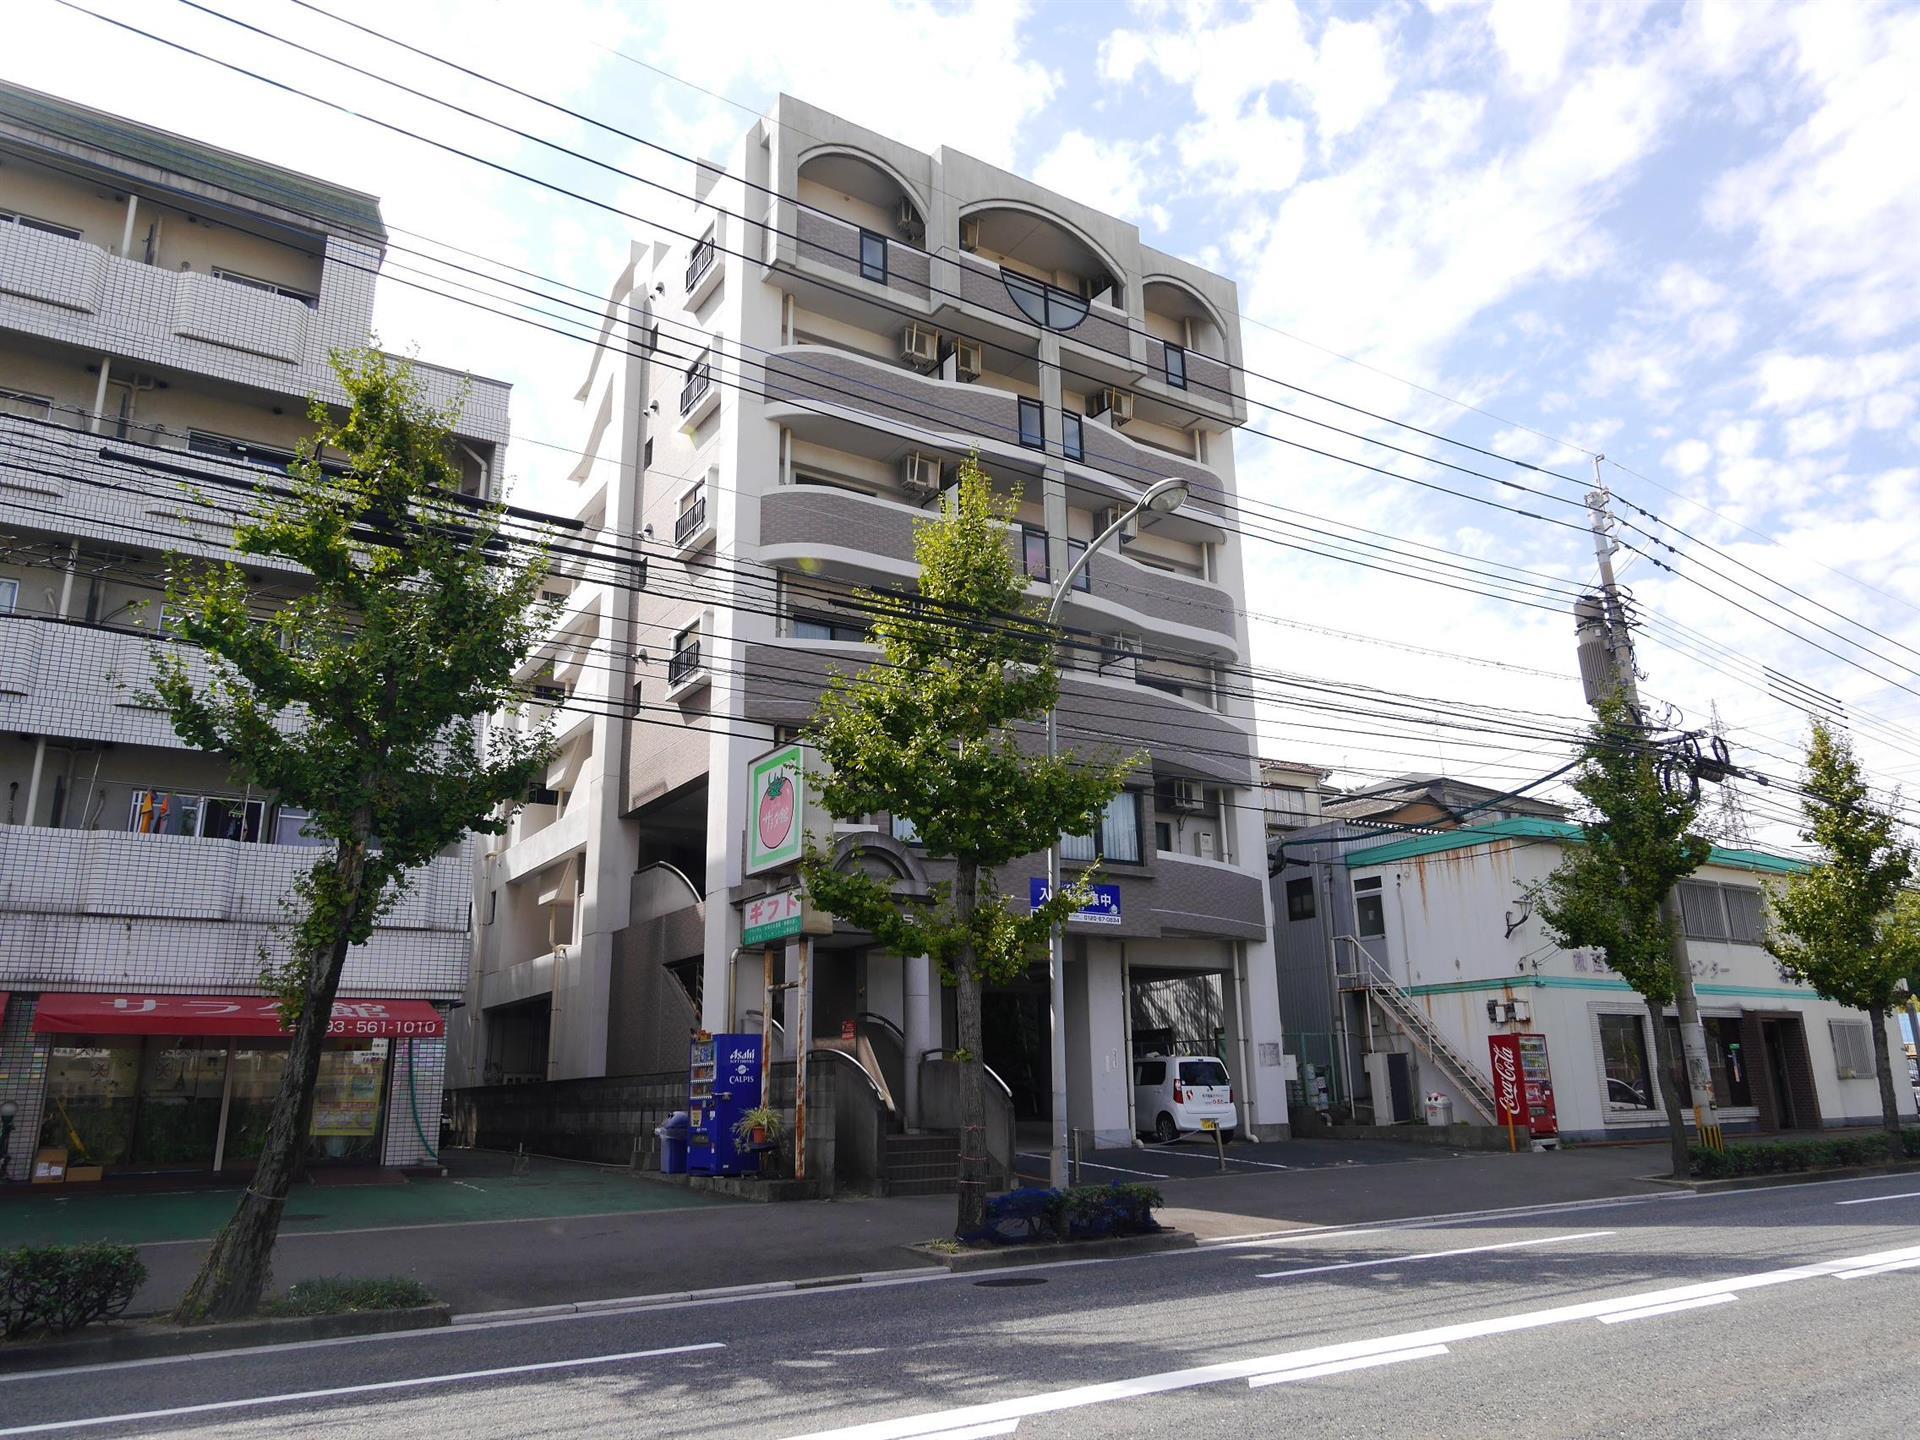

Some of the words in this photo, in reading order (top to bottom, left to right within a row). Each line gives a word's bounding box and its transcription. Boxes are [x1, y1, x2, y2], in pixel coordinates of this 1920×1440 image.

[750, 894, 797, 925] ギフト
[730, 1049, 755, 1060] Asahi
[729, 1075, 754, 1085] CALPIS
[1492, 1044, 1520, 1115] Coca-Cola
